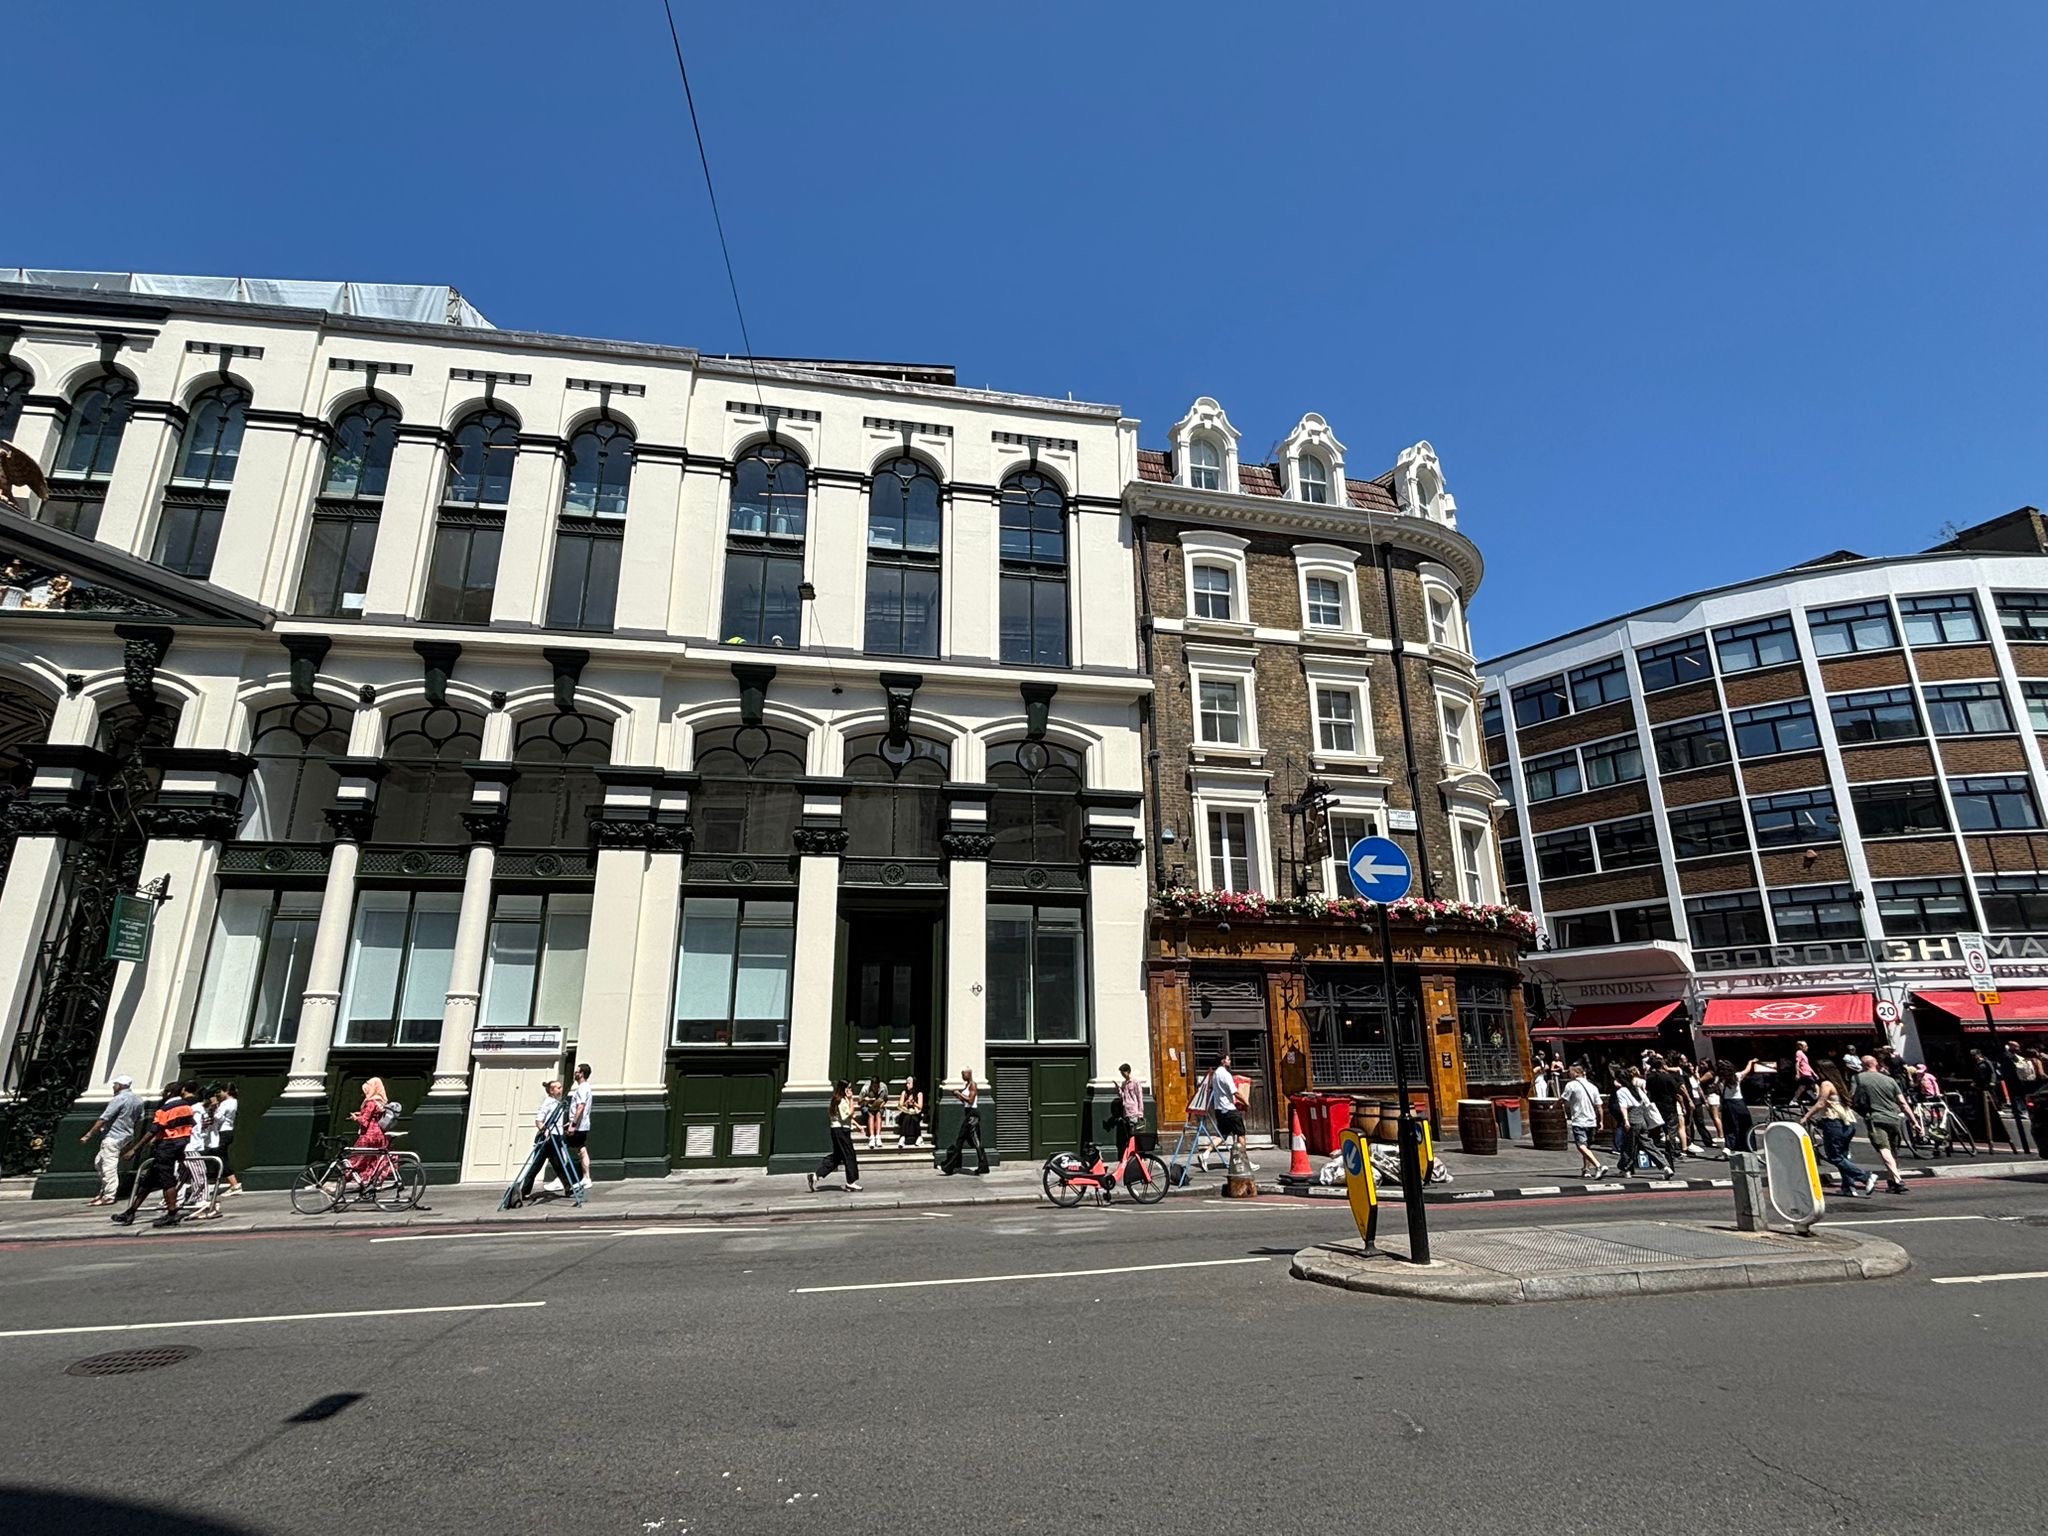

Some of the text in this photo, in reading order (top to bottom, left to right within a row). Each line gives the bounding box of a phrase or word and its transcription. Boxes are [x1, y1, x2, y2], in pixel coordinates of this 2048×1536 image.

[1705, 938, 1953, 970] BOROUGH
[1580, 982, 1656, 997] BRINDISA
[1878, 1006, 1895, 1016] 20
